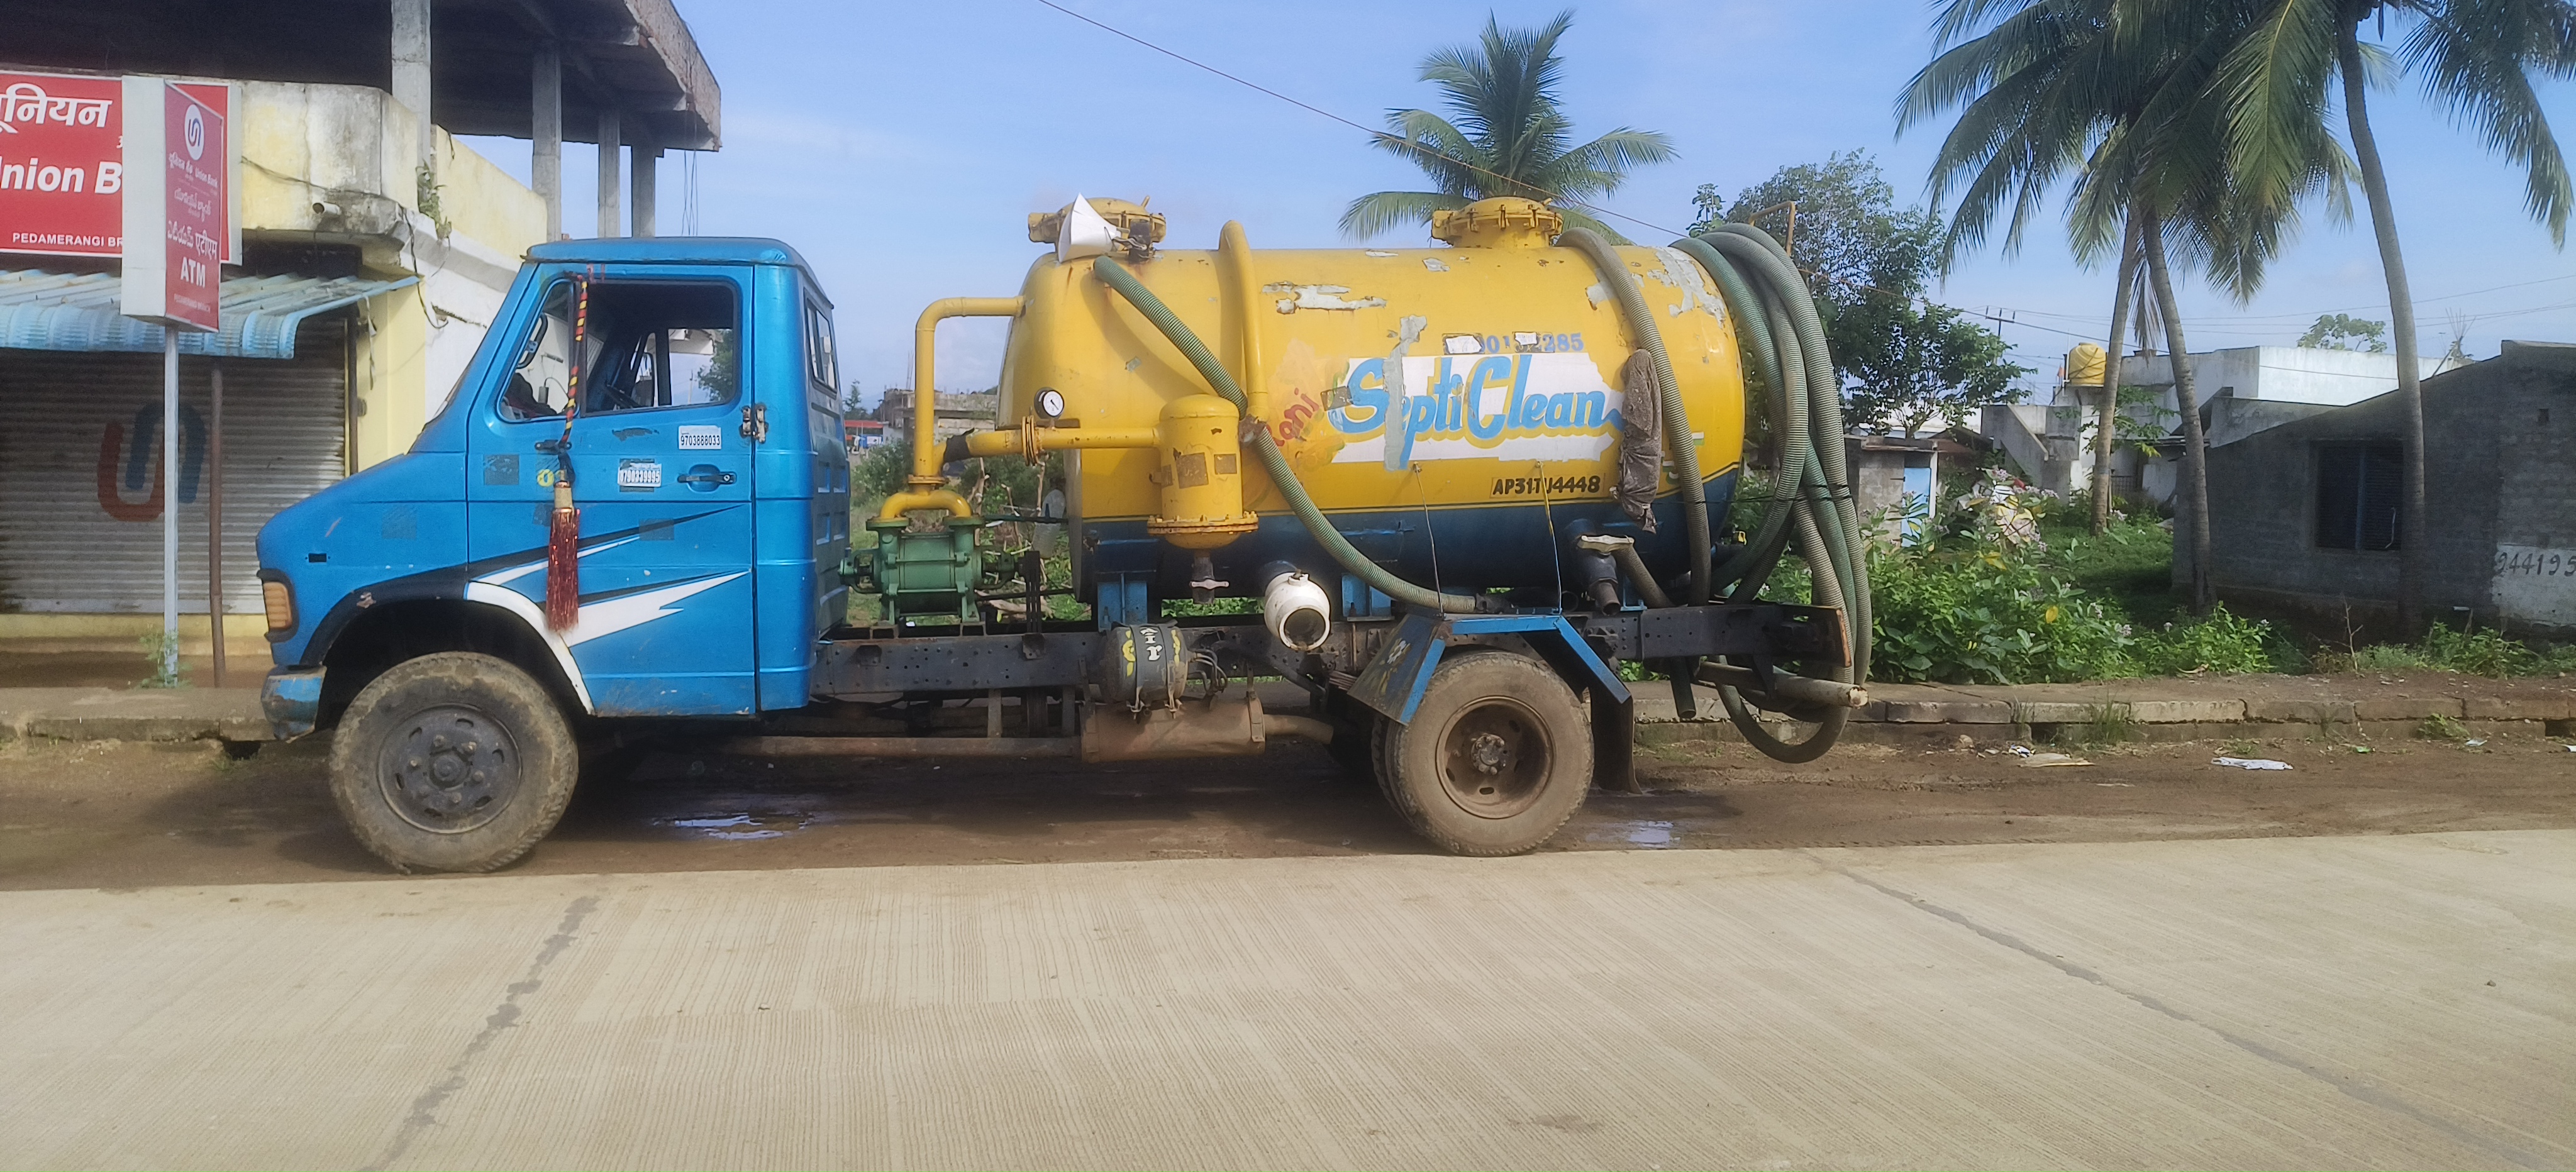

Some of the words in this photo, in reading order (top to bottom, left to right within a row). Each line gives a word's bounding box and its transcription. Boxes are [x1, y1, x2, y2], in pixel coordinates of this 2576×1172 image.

[0, 155, 85, 193] nion
[13, 232, 104, 247] PEDAMERANGI
[180, 256, 206, 289] ATM
[680, 434, 720, 446] 9703888033
